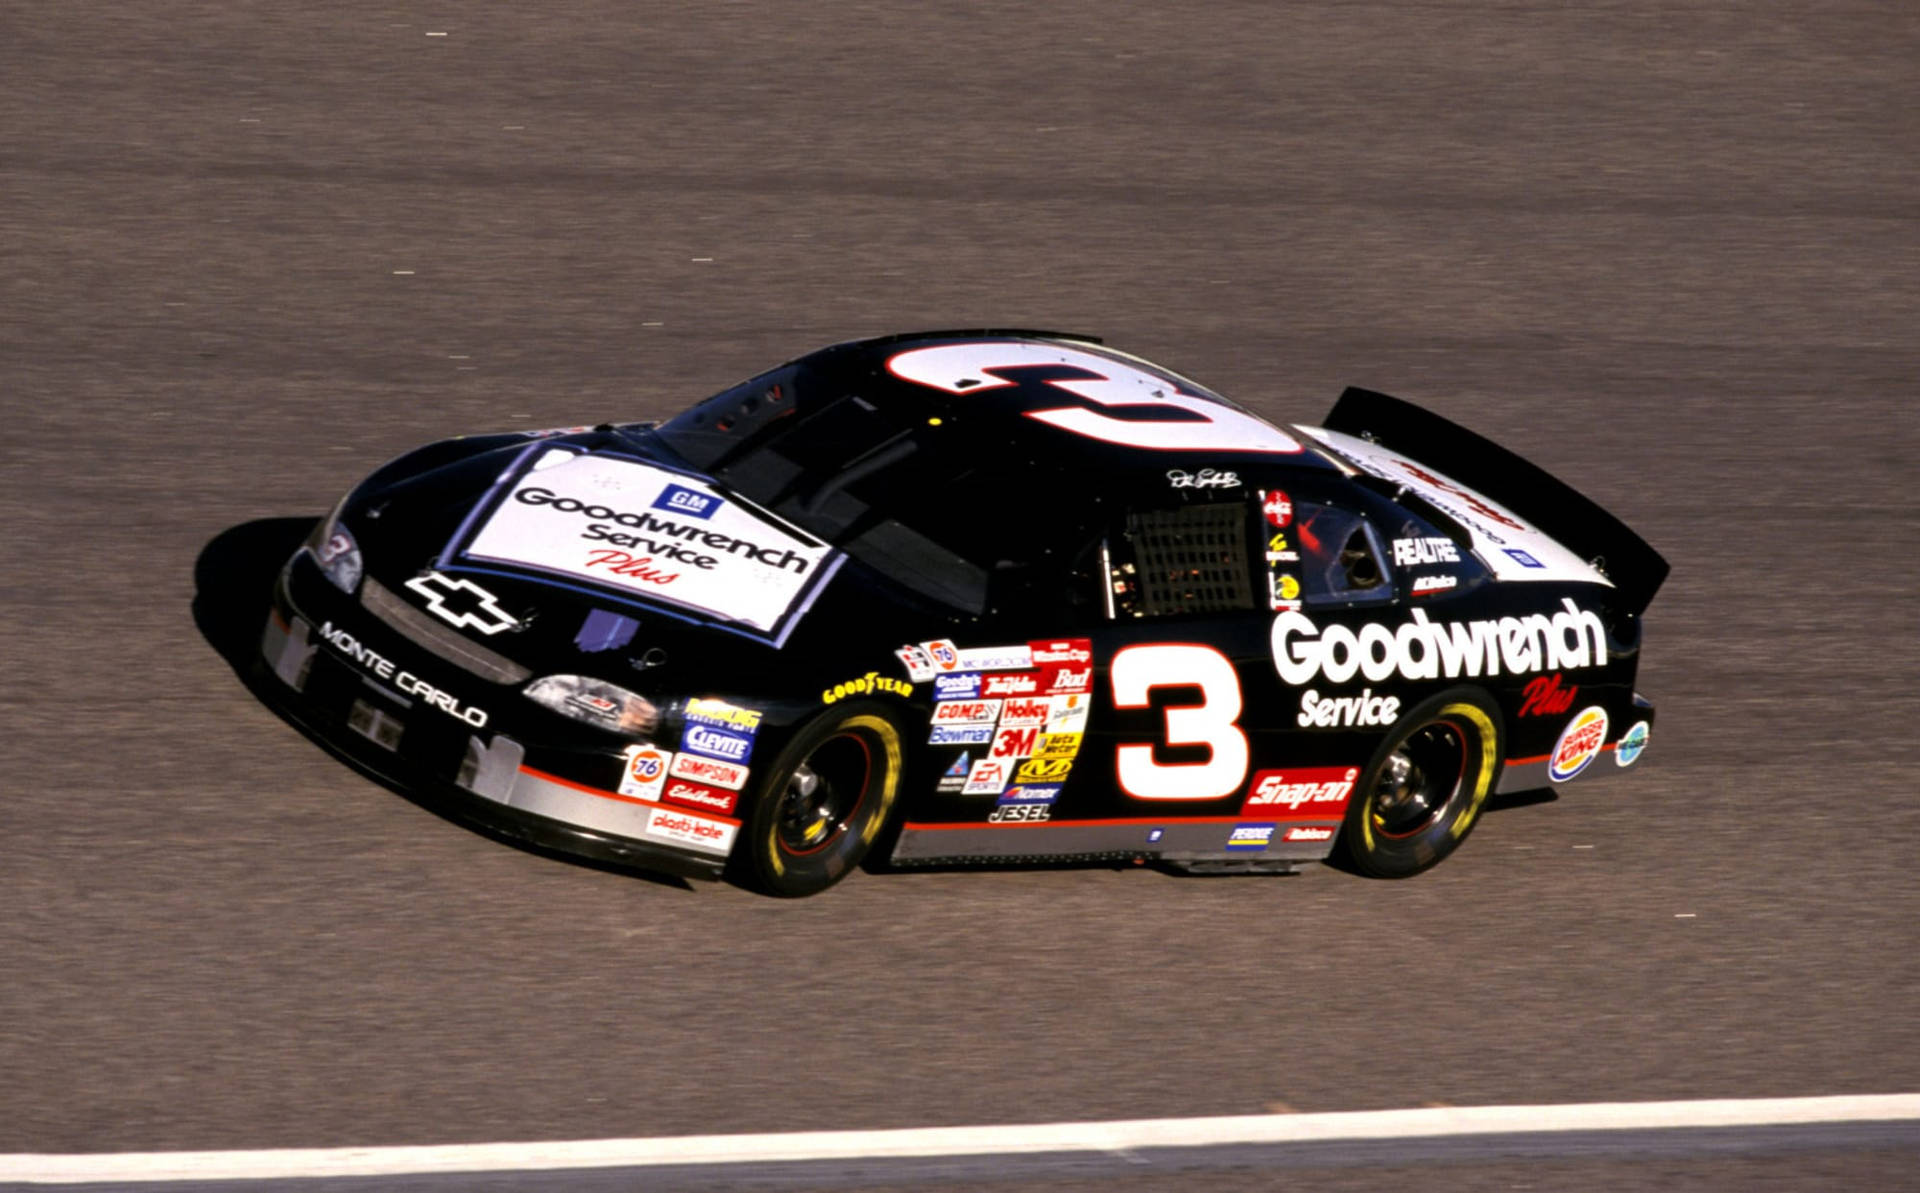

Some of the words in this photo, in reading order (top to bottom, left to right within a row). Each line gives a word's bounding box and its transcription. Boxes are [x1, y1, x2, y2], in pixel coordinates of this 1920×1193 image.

[885, 342, 1304, 454] 3
[670, 490, 710, 514] GM
[514, 486, 809, 575] Goodwrench
[581, 523, 718, 571] Service
[585, 549, 681, 585] Plus
[935, 648, 954, 663] 76
[1271, 597, 1608, 685] Goodwrench
[319, 621, 396, 680] MONTE
[395, 673, 489, 728] CARLO
[822, 671, 914, 705] GOODYEAR
[1053, 668, 1092, 688] Bud
[937, 703, 985, 719] COMP
[1004, 698, 1049, 726] Holley
[1297, 688, 1401, 727] Service
[1518, 673, 1578, 717] Plus
[931, 726, 993, 743] Bowman
[1110, 641, 1250, 801] 3
[687, 725, 750, 757] CLEVITE
[994, 727, 1038, 758] 3M
[1554, 732, 1602, 768] KING
[636, 758, 658, 776] 76
[677, 758, 741, 784] SIMPSON
[1247, 776, 1354, 810] Snap-on
[988, 803, 1051, 824] JESEL
